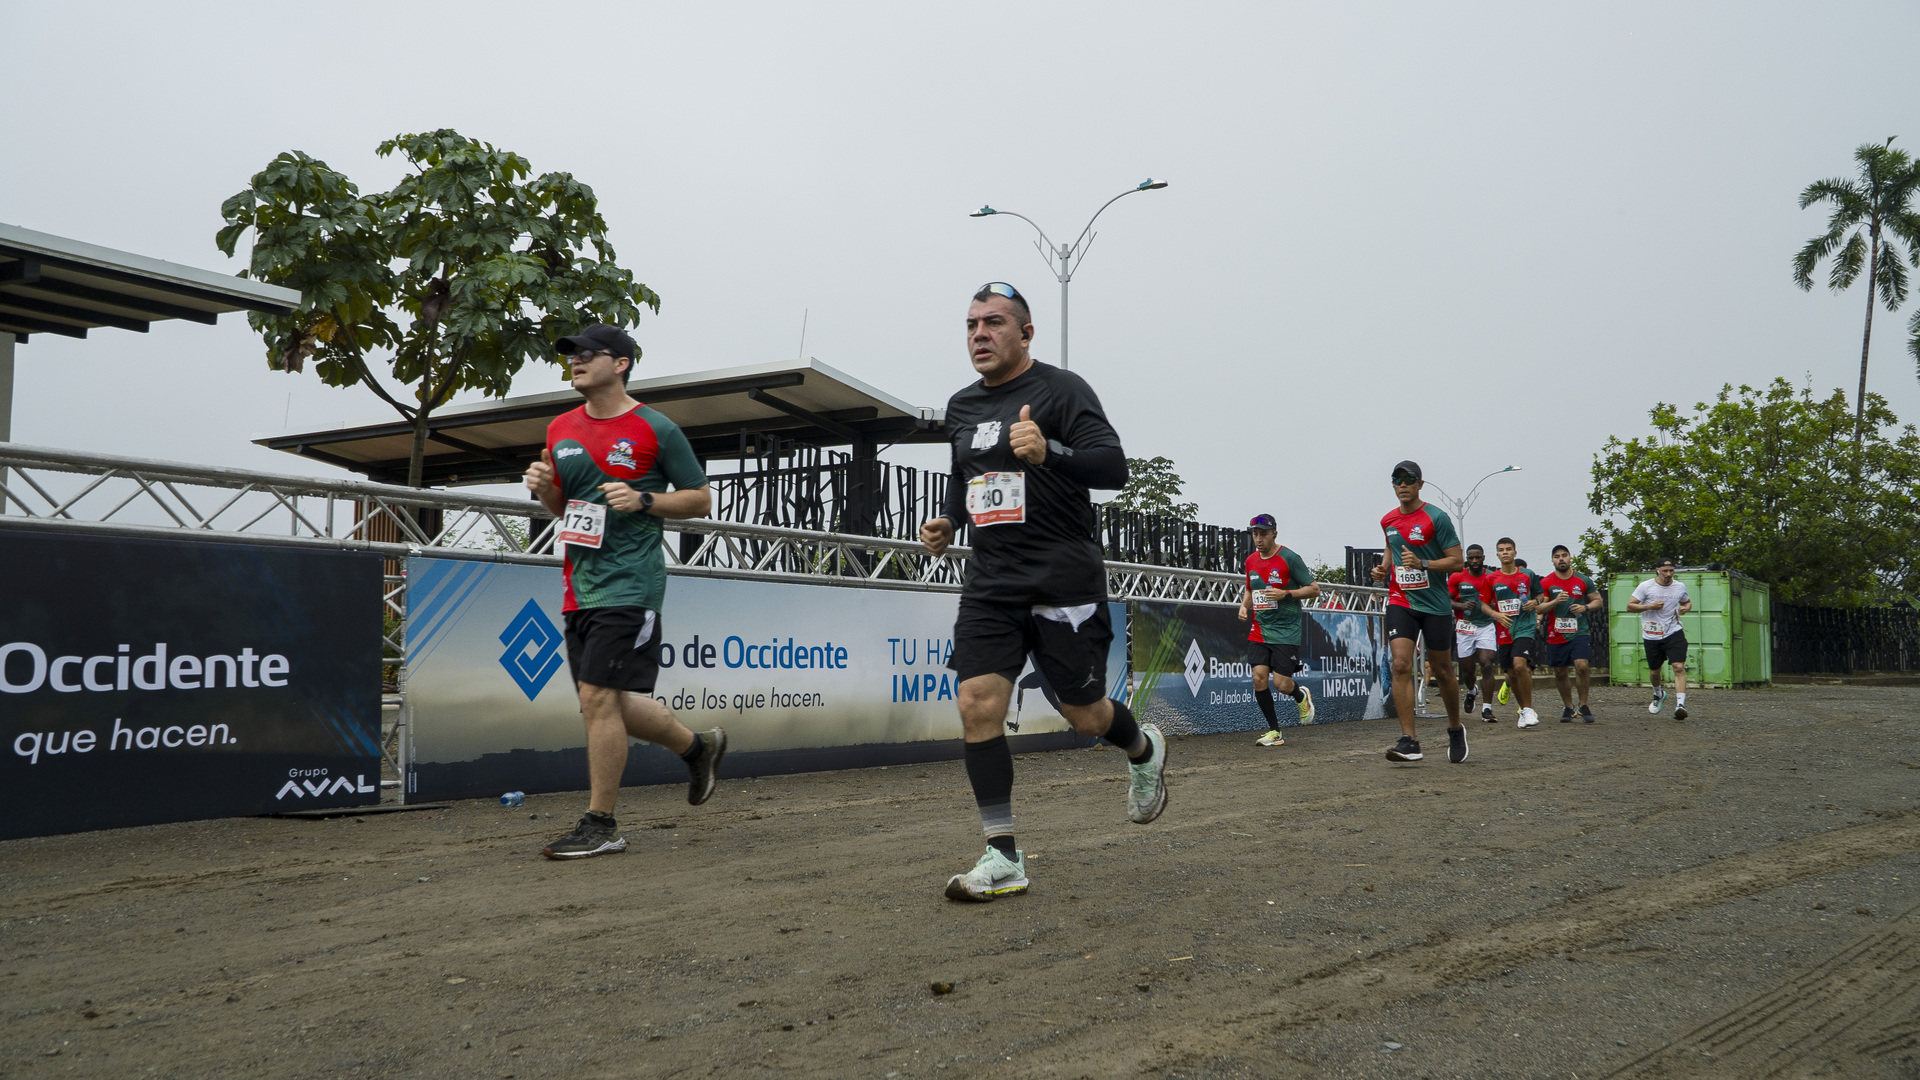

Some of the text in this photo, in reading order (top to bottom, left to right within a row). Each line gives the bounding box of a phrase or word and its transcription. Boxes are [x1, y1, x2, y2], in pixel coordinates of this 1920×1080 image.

[1400, 573, 1422, 583] 1693
[1502, 604, 1519, 612] 1769
[682, 634, 716, 669] de
[723, 635, 848, 669] Occidente
[888, 638, 955, 666] TU HA
[0, 641, 290, 694] Occidente
[1210, 656, 1244, 679] Banco
[1320, 656, 1333, 674] TU
[1335, 656, 1369, 675] HACER,
[892, 673, 958, 703] IMPA
[1210, 690, 1222, 704] Del
[1224, 689, 1241, 703] lado
[1242, 689, 1251, 702] de
[1322, 678, 1371, 698] IMPACTA.
[672, 688, 696, 711] de
[702, 687, 728, 710] los
[732, 693, 766, 715] que
[770, 687, 826, 708] hacen.
[13, 718, 238, 765] que hacen.
[288, 767, 329, 778] Grupo
[275, 774, 375, 800] AVAL
